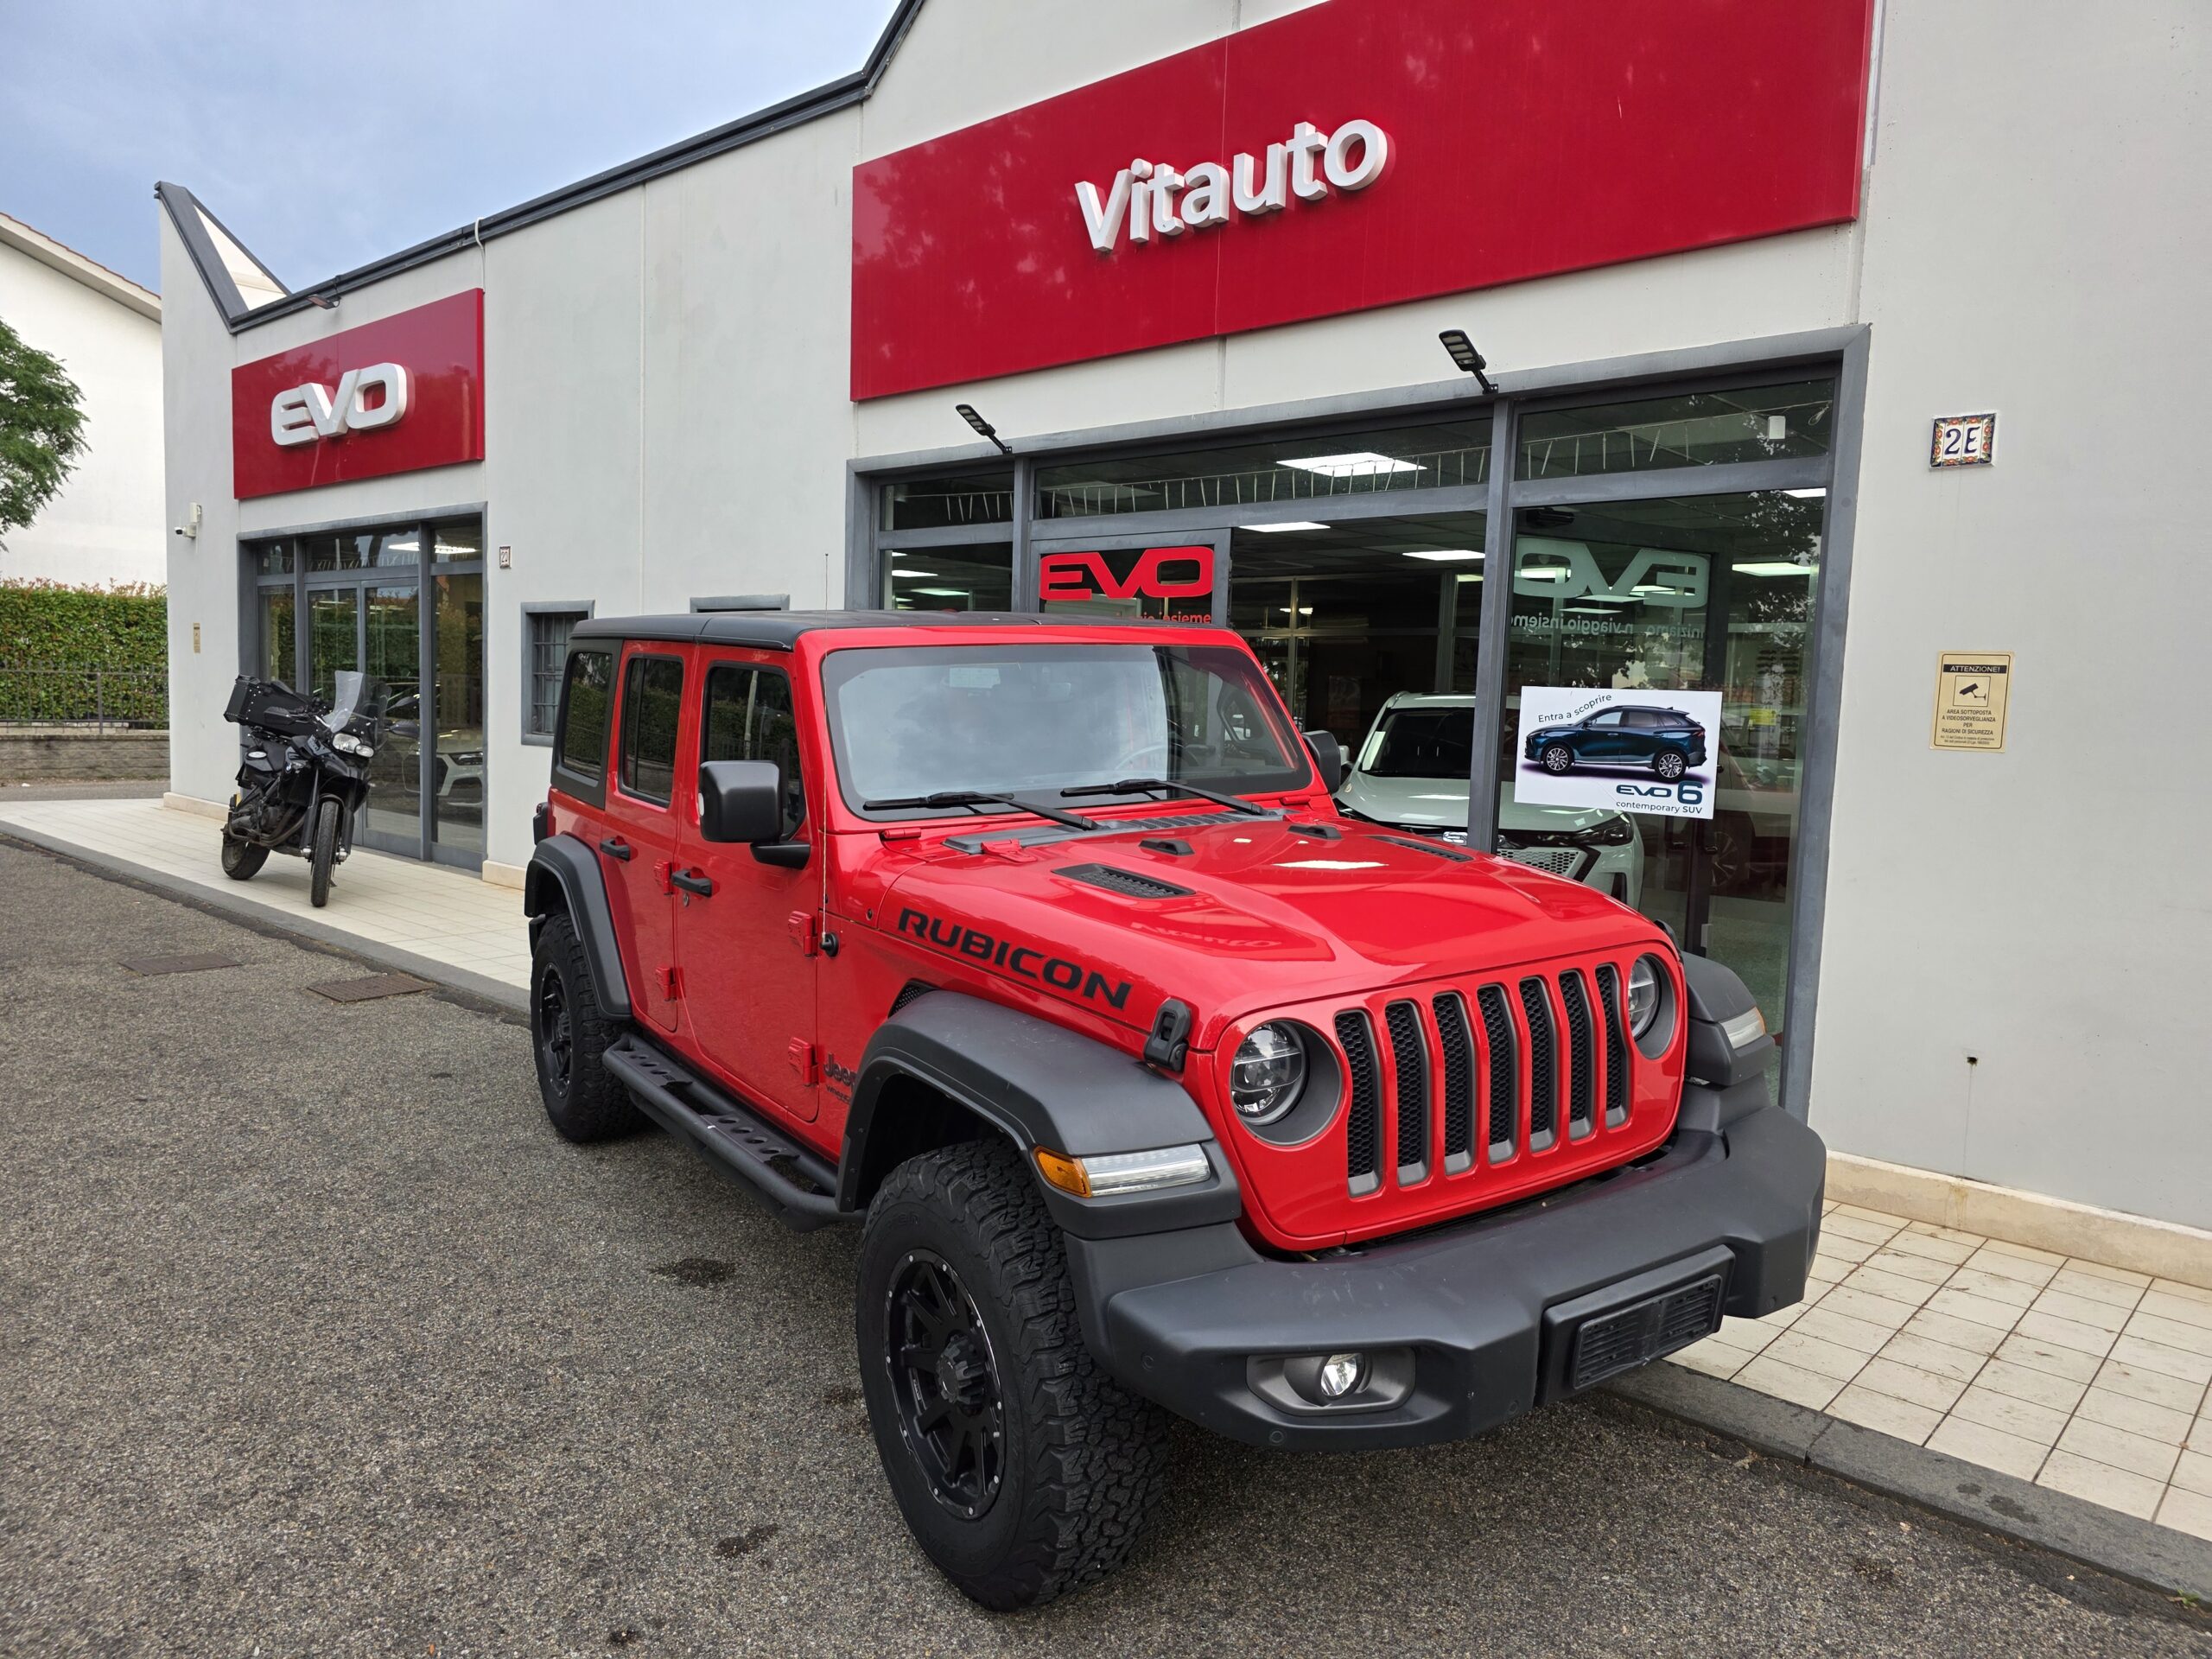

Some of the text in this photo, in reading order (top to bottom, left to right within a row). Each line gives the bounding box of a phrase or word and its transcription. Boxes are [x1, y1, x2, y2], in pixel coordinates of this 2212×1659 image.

[1074, 118, 1388, 251] Vitauto
[270, 362, 408, 447] EVO
[1944, 426, 1980, 455] 2E
[1039, 546, 1215, 601] EVO
[1538, 713, 1563, 723] Entra
[1574, 693, 1612, 716] scoprire
[1616, 780, 1703, 805] EVO 6
[1616, 800, 1703, 815] contemporary SUV
[896, 906, 1135, 1011] RUBICON
